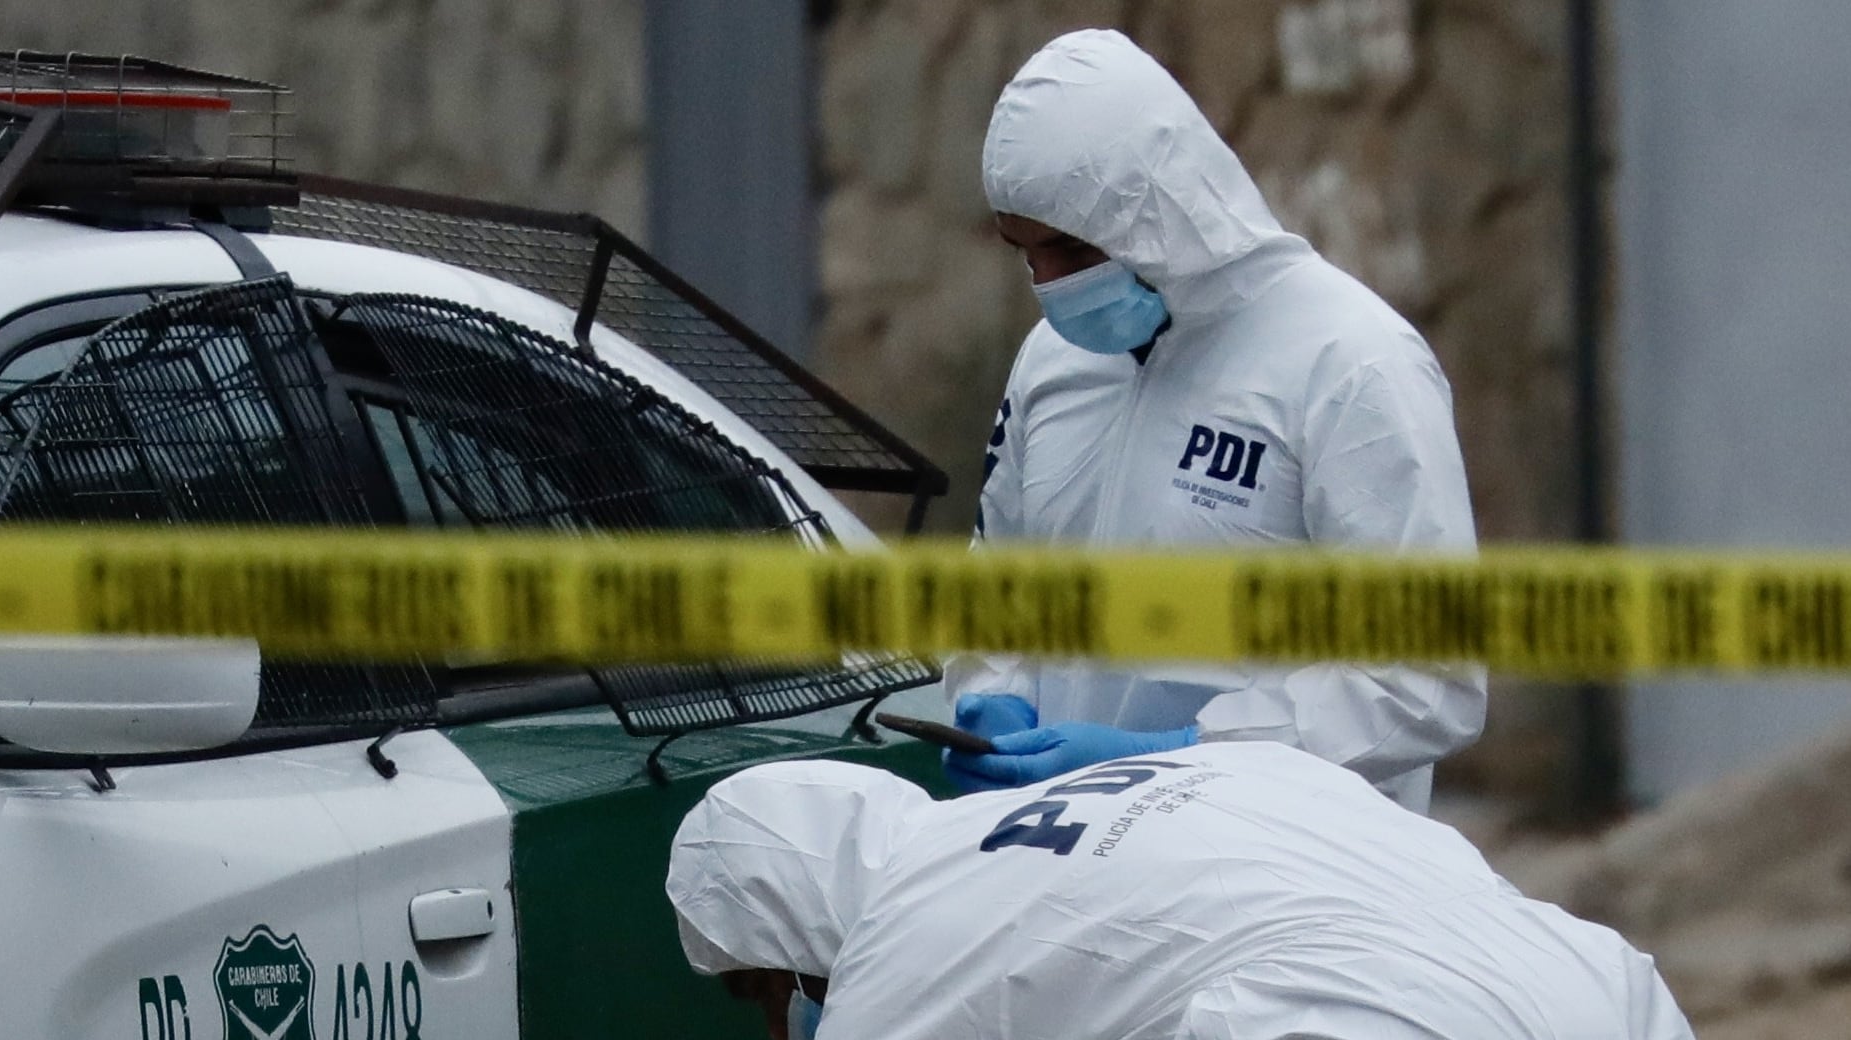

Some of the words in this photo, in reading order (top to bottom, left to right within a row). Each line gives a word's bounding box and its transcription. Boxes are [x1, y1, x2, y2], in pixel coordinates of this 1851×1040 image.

[1177, 423, 1267, 490] PDI
[1126, 801, 1151, 816] DE
[228, 963, 288, 987] CARABINEROS
[288, 962, 302, 984] DE
[254, 986, 280, 1008] CHILE
